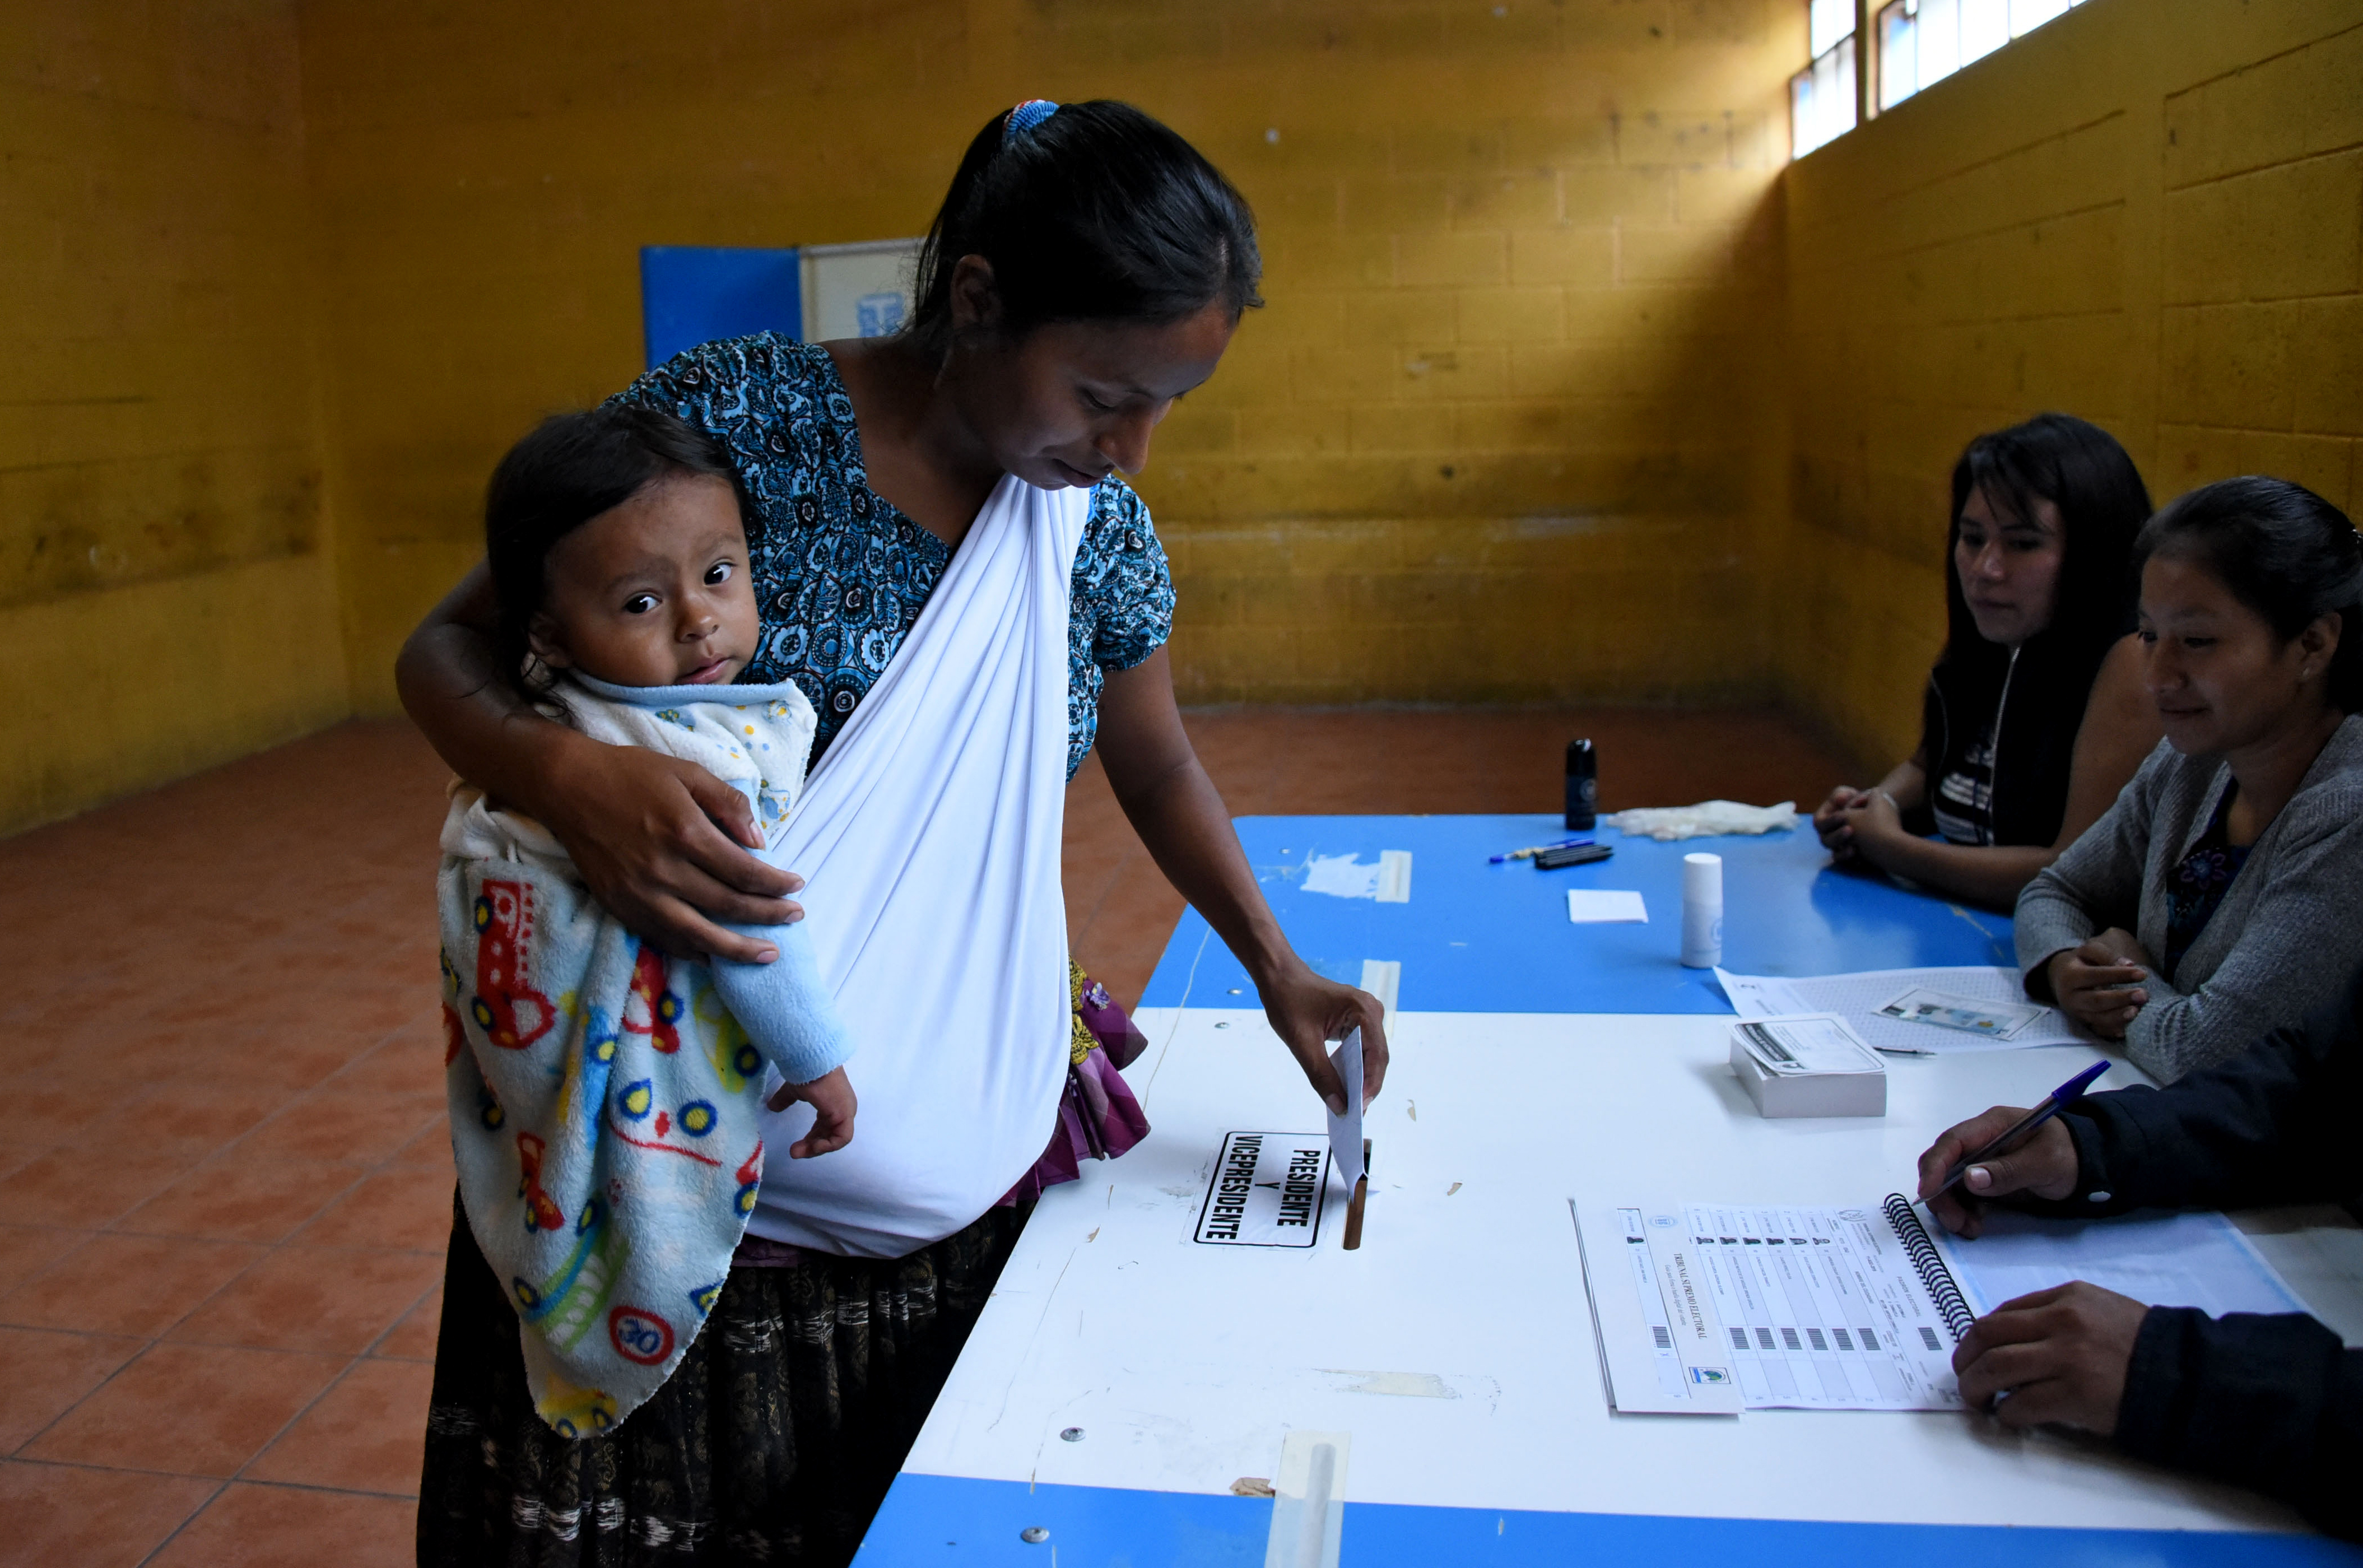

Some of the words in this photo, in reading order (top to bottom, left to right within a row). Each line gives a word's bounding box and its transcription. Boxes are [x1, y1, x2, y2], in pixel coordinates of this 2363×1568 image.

[1206, 1136, 1263, 1240] VICEPRESIDENTE
[1277, 1150, 1321, 1227] PRESIDENTE
[1674, 1253, 1688, 1279] TRIBUNAL
[1681, 1279, 1696, 1305] SUPREMO
[1689, 1306, 1708, 1339] ELECTORAL
